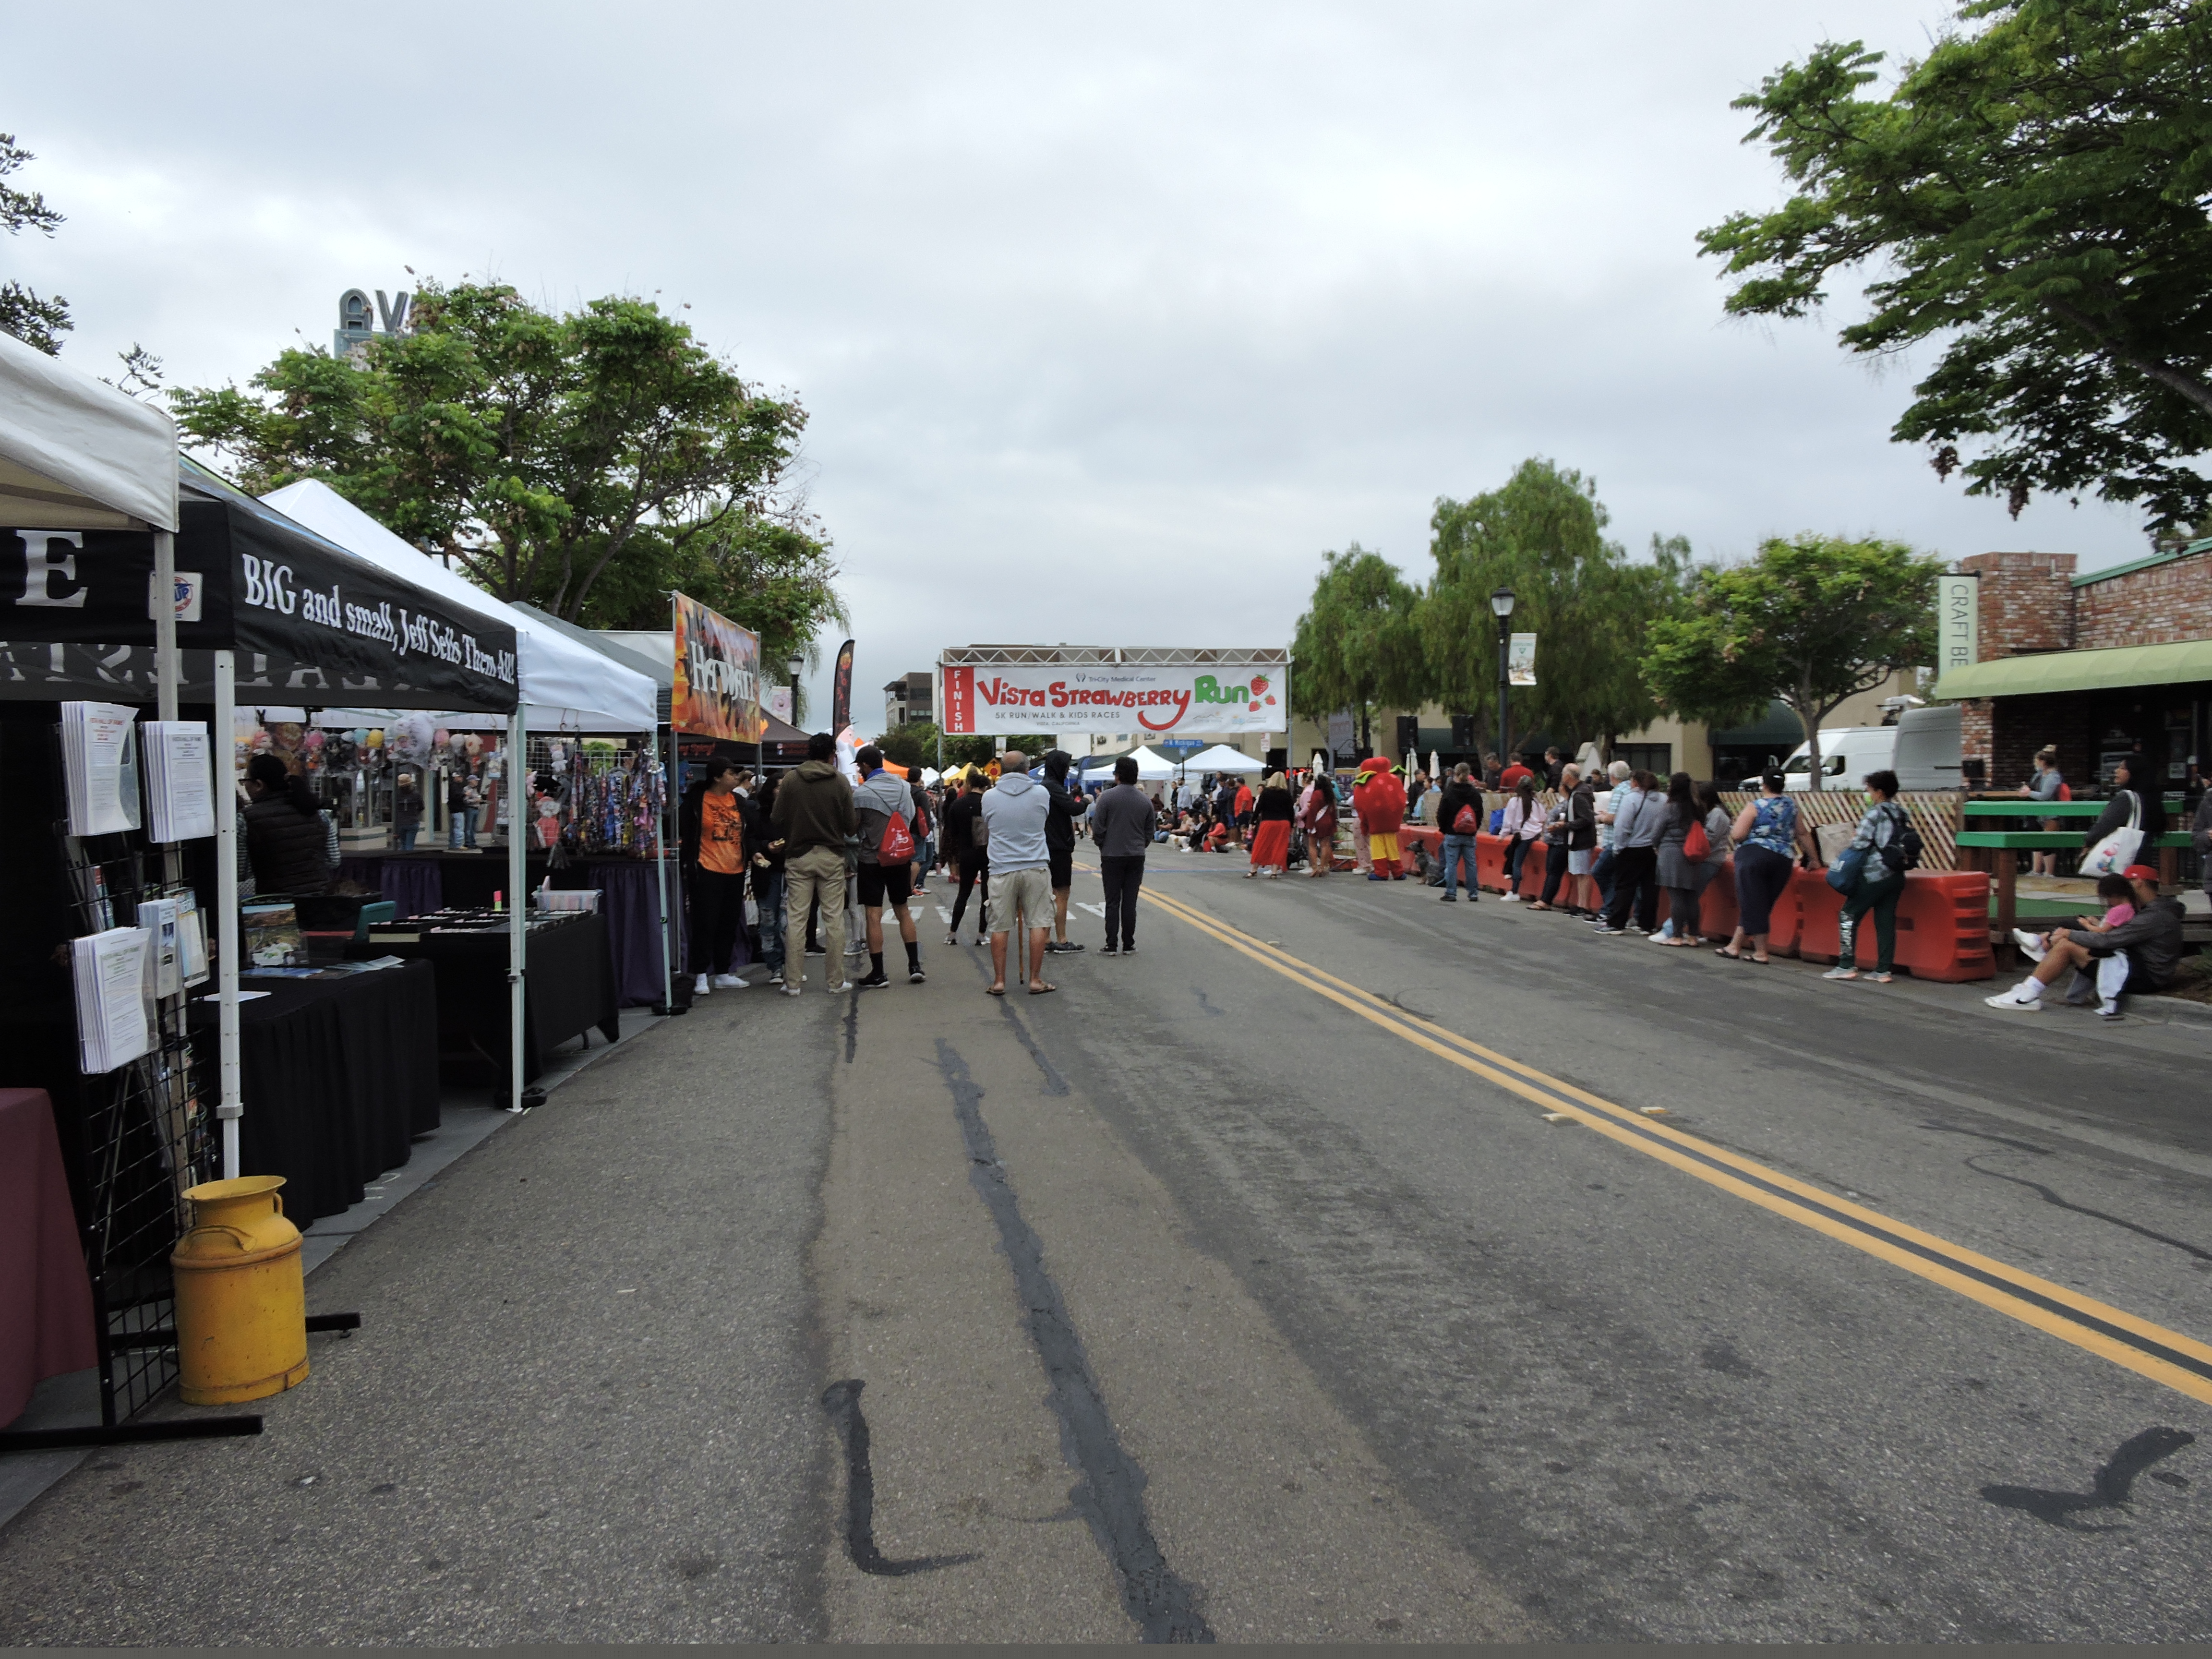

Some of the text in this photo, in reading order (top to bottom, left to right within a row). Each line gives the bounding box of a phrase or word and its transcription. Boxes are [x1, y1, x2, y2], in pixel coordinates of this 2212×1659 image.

[242, 553, 515, 685] BIG and small, Jeff Sells Them All!
[1950, 584, 1969, 641] CRAFT
[953, 670, 963, 732] FINISH
